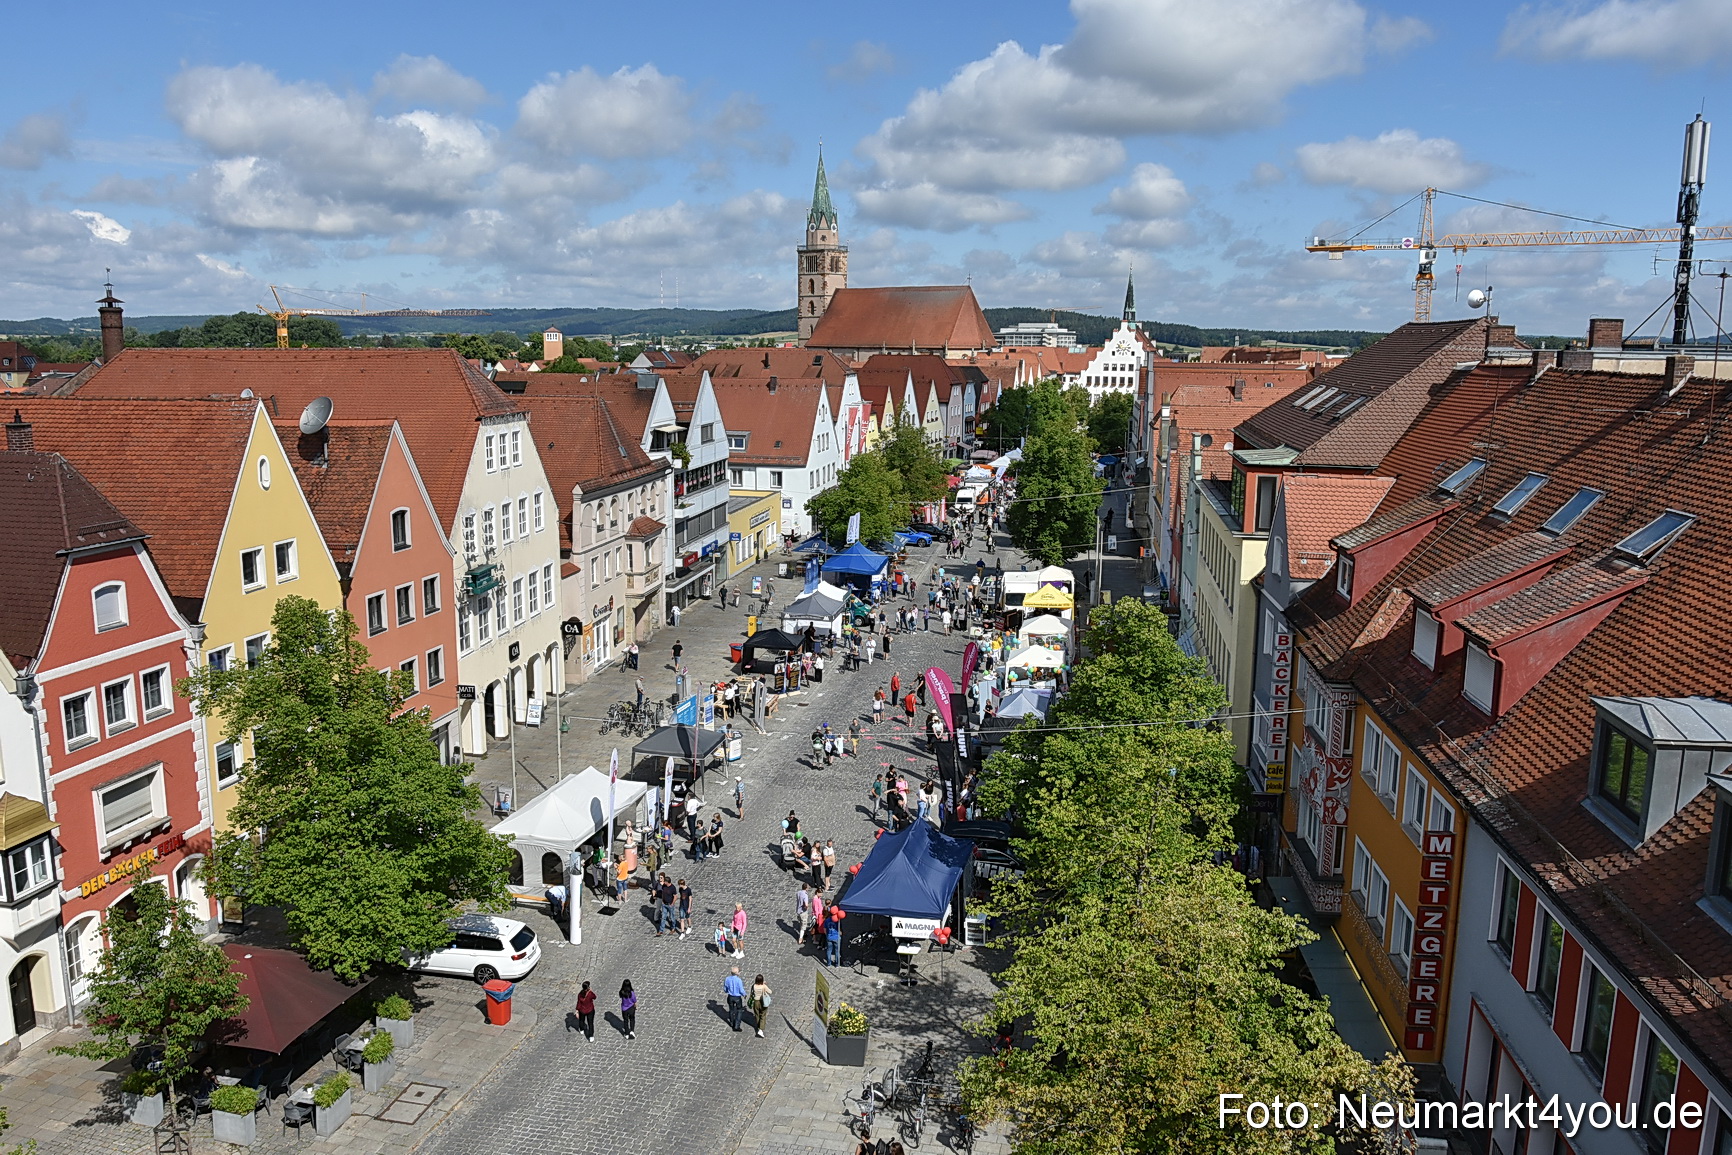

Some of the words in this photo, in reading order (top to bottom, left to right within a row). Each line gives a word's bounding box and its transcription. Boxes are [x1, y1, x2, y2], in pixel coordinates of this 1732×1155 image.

[860, 419, 869, 440] SALE
[1271, 634, 1290, 761] BÄCKEREI
[1266, 764, 1284, 776] café
[81, 874, 106, 897] DER
[108, 848, 156, 883] BÄCKER
[904, 922, 936, 931] MAGNA
[1415, 836, 1452, 1049] METZGEREI
